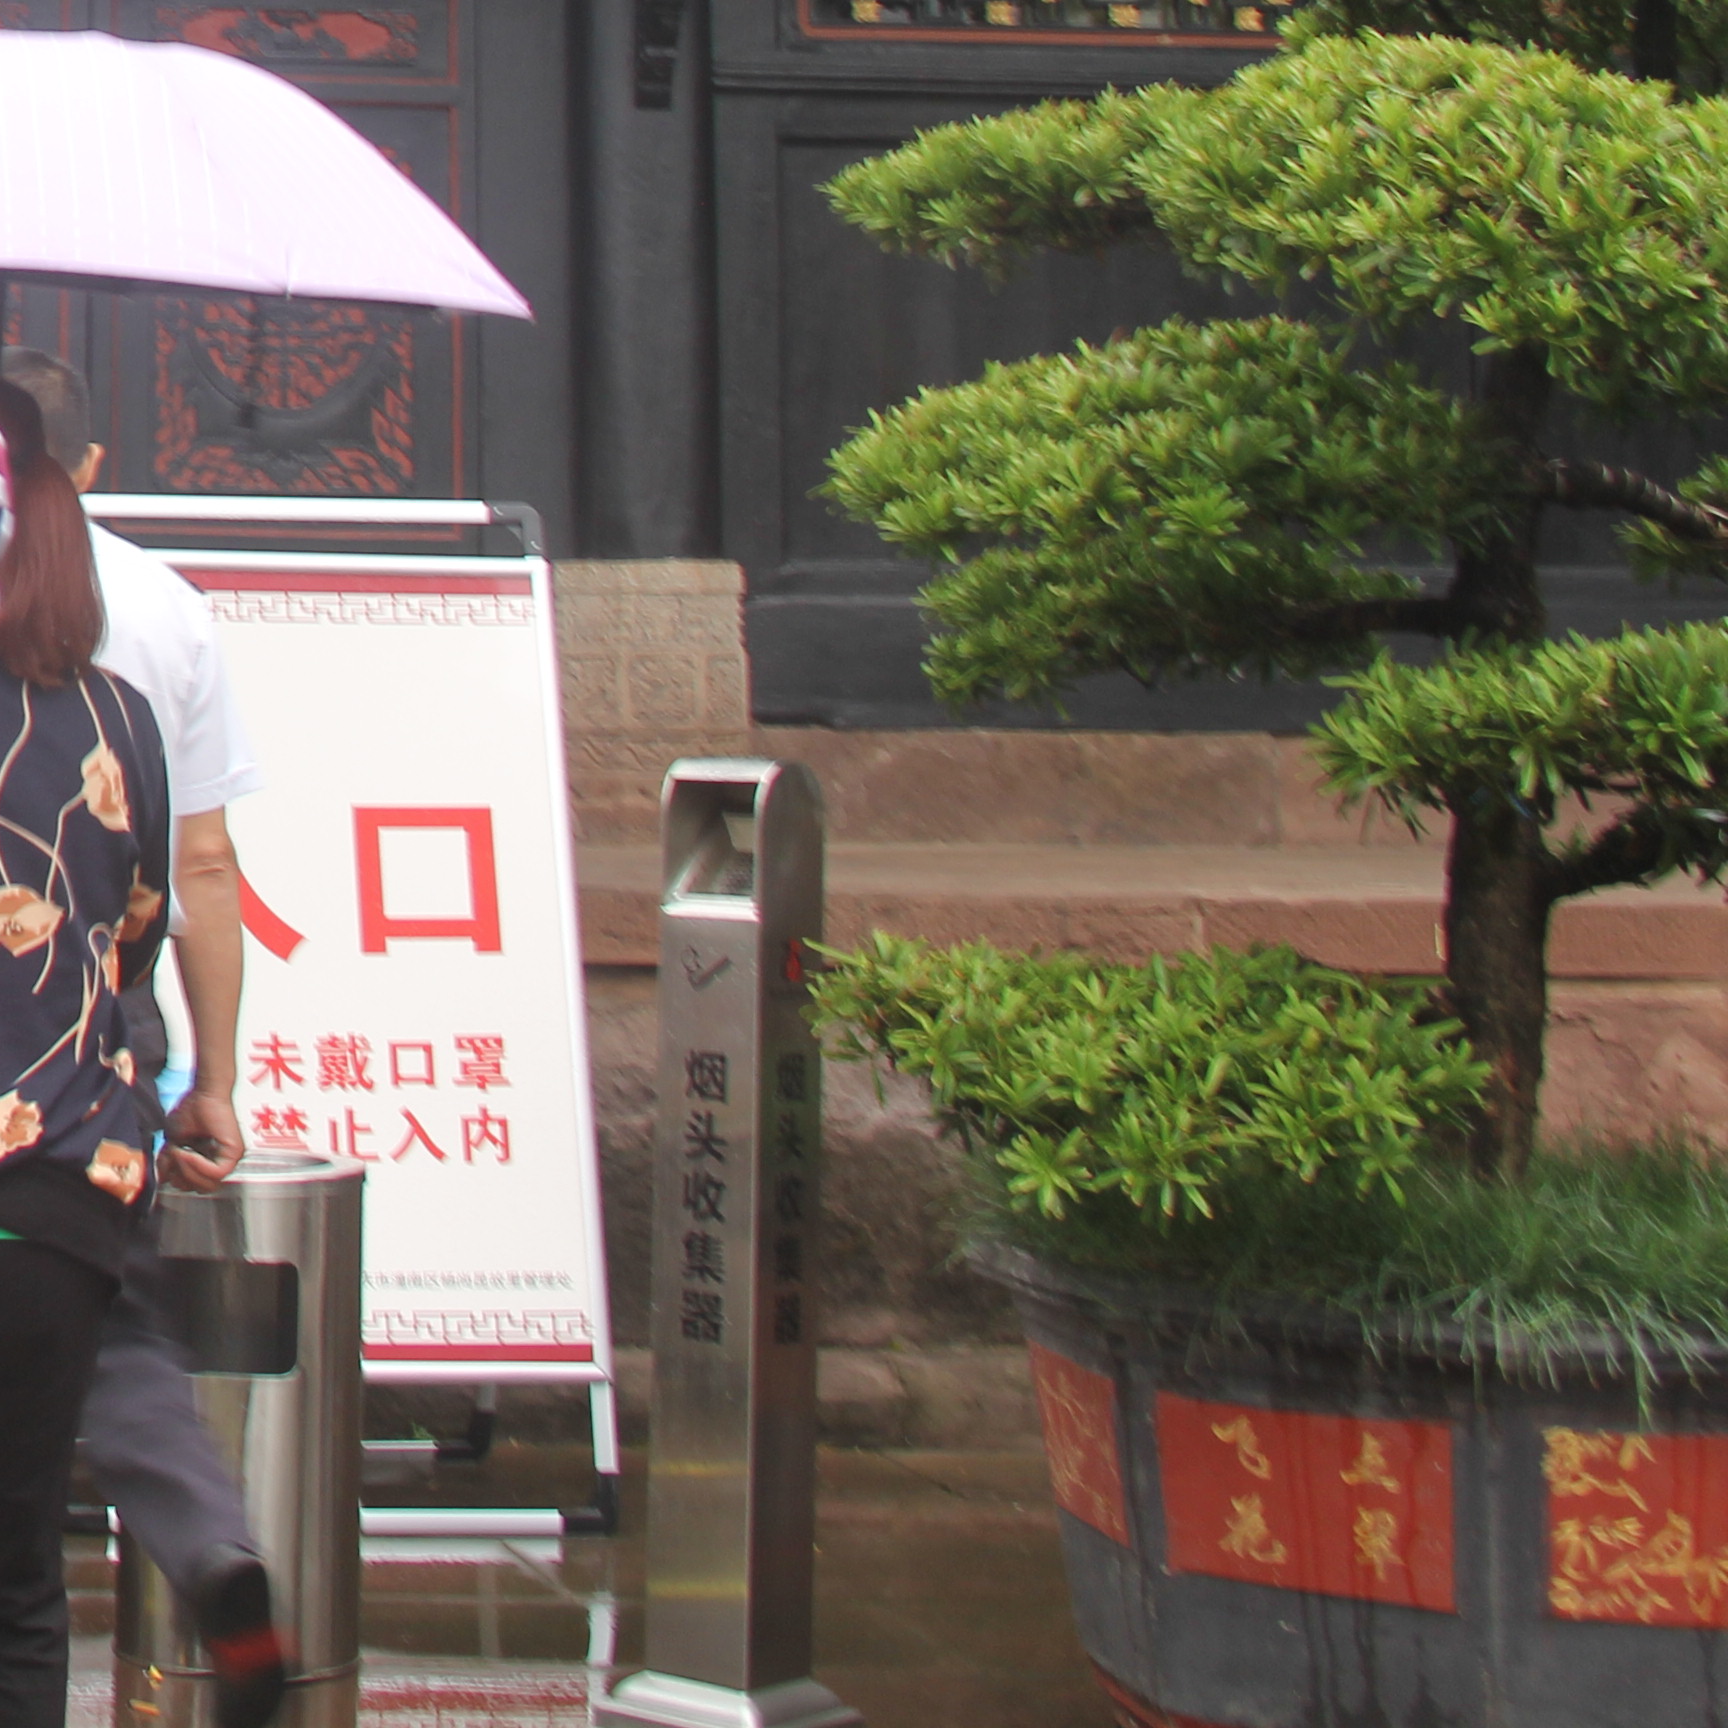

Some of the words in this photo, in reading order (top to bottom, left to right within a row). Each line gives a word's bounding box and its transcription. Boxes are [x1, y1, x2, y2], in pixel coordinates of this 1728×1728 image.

[248, 1031, 510, 1092] 未戴口罩
[249, 1104, 512, 1163] 禁止入内
[681, 1049, 729, 1344] 烟头收集器
